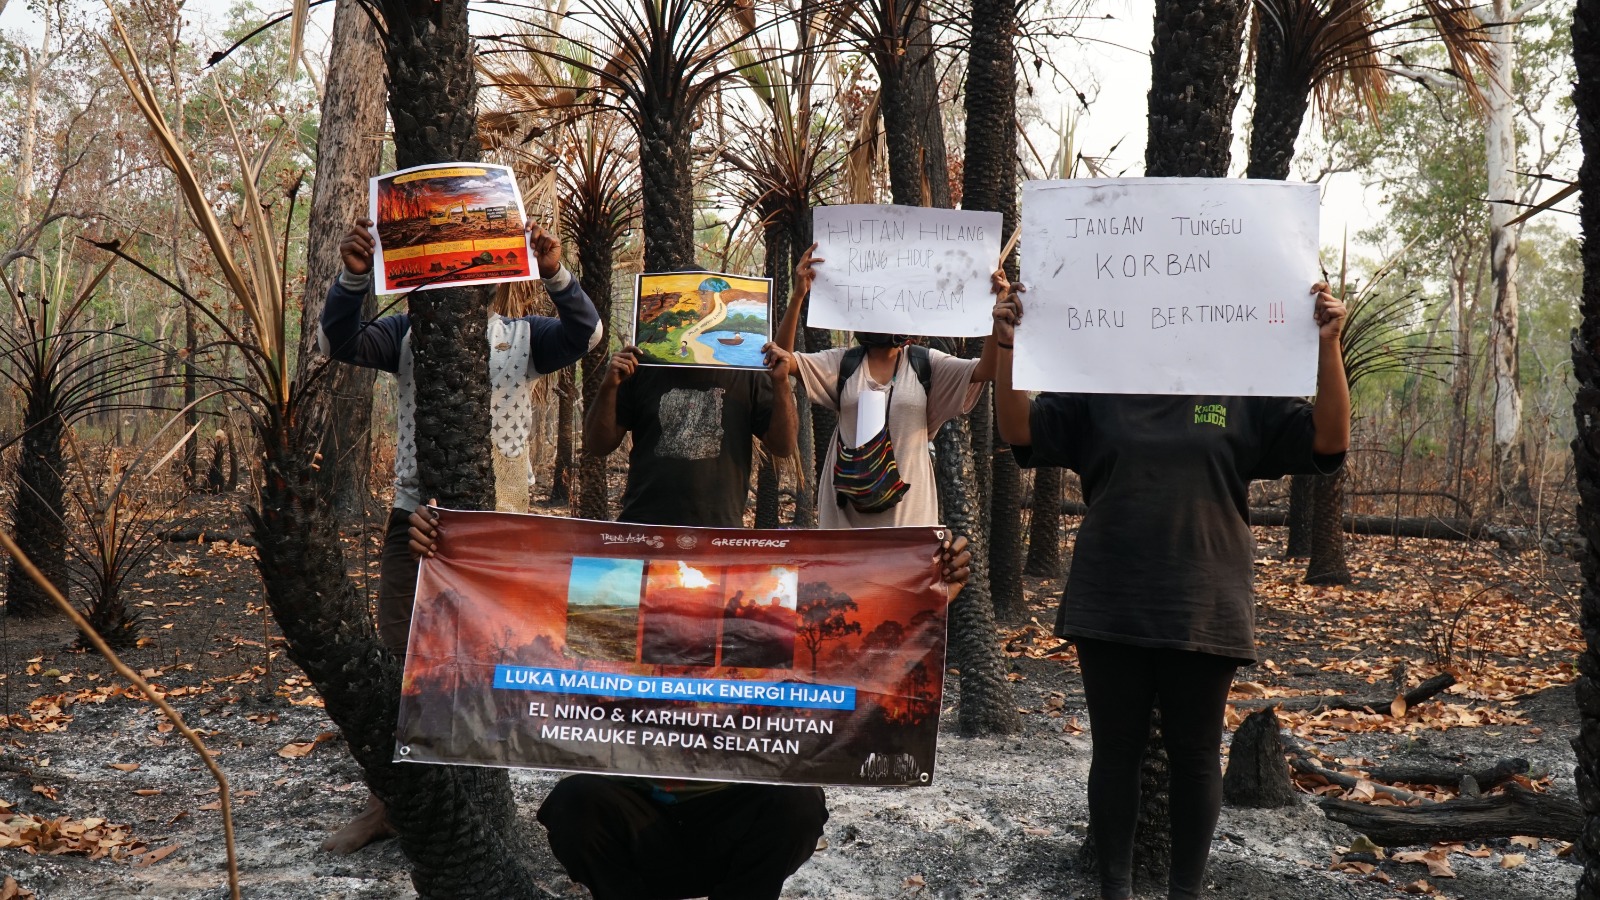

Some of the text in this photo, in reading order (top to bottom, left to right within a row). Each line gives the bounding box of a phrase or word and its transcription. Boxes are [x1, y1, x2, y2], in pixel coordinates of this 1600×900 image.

[828, 219, 984, 245] HUTAN HILANG
[1065, 216, 1243, 239] JANGAN TUNGGU
[848, 247, 935, 276] RUANG HIDUP
[1096, 250, 1212, 280] KORBAN
[1067, 307, 1125, 331] BARU
[1151, 304, 1258, 330] BERTINDAK
[1194, 412, 1226, 428] MUDA
[600, 532, 625, 542] TREND
[711, 537, 790, 548] GREENPEACE
[505, 669, 845, 704] LUKA MALIND DI BALIK ENERGI HIJAU
[528, 702, 834, 735] EL NINO & KARHUTLA DI HUTAN
[541, 724, 800, 755] MERAUKE PAPUA SELATAN
